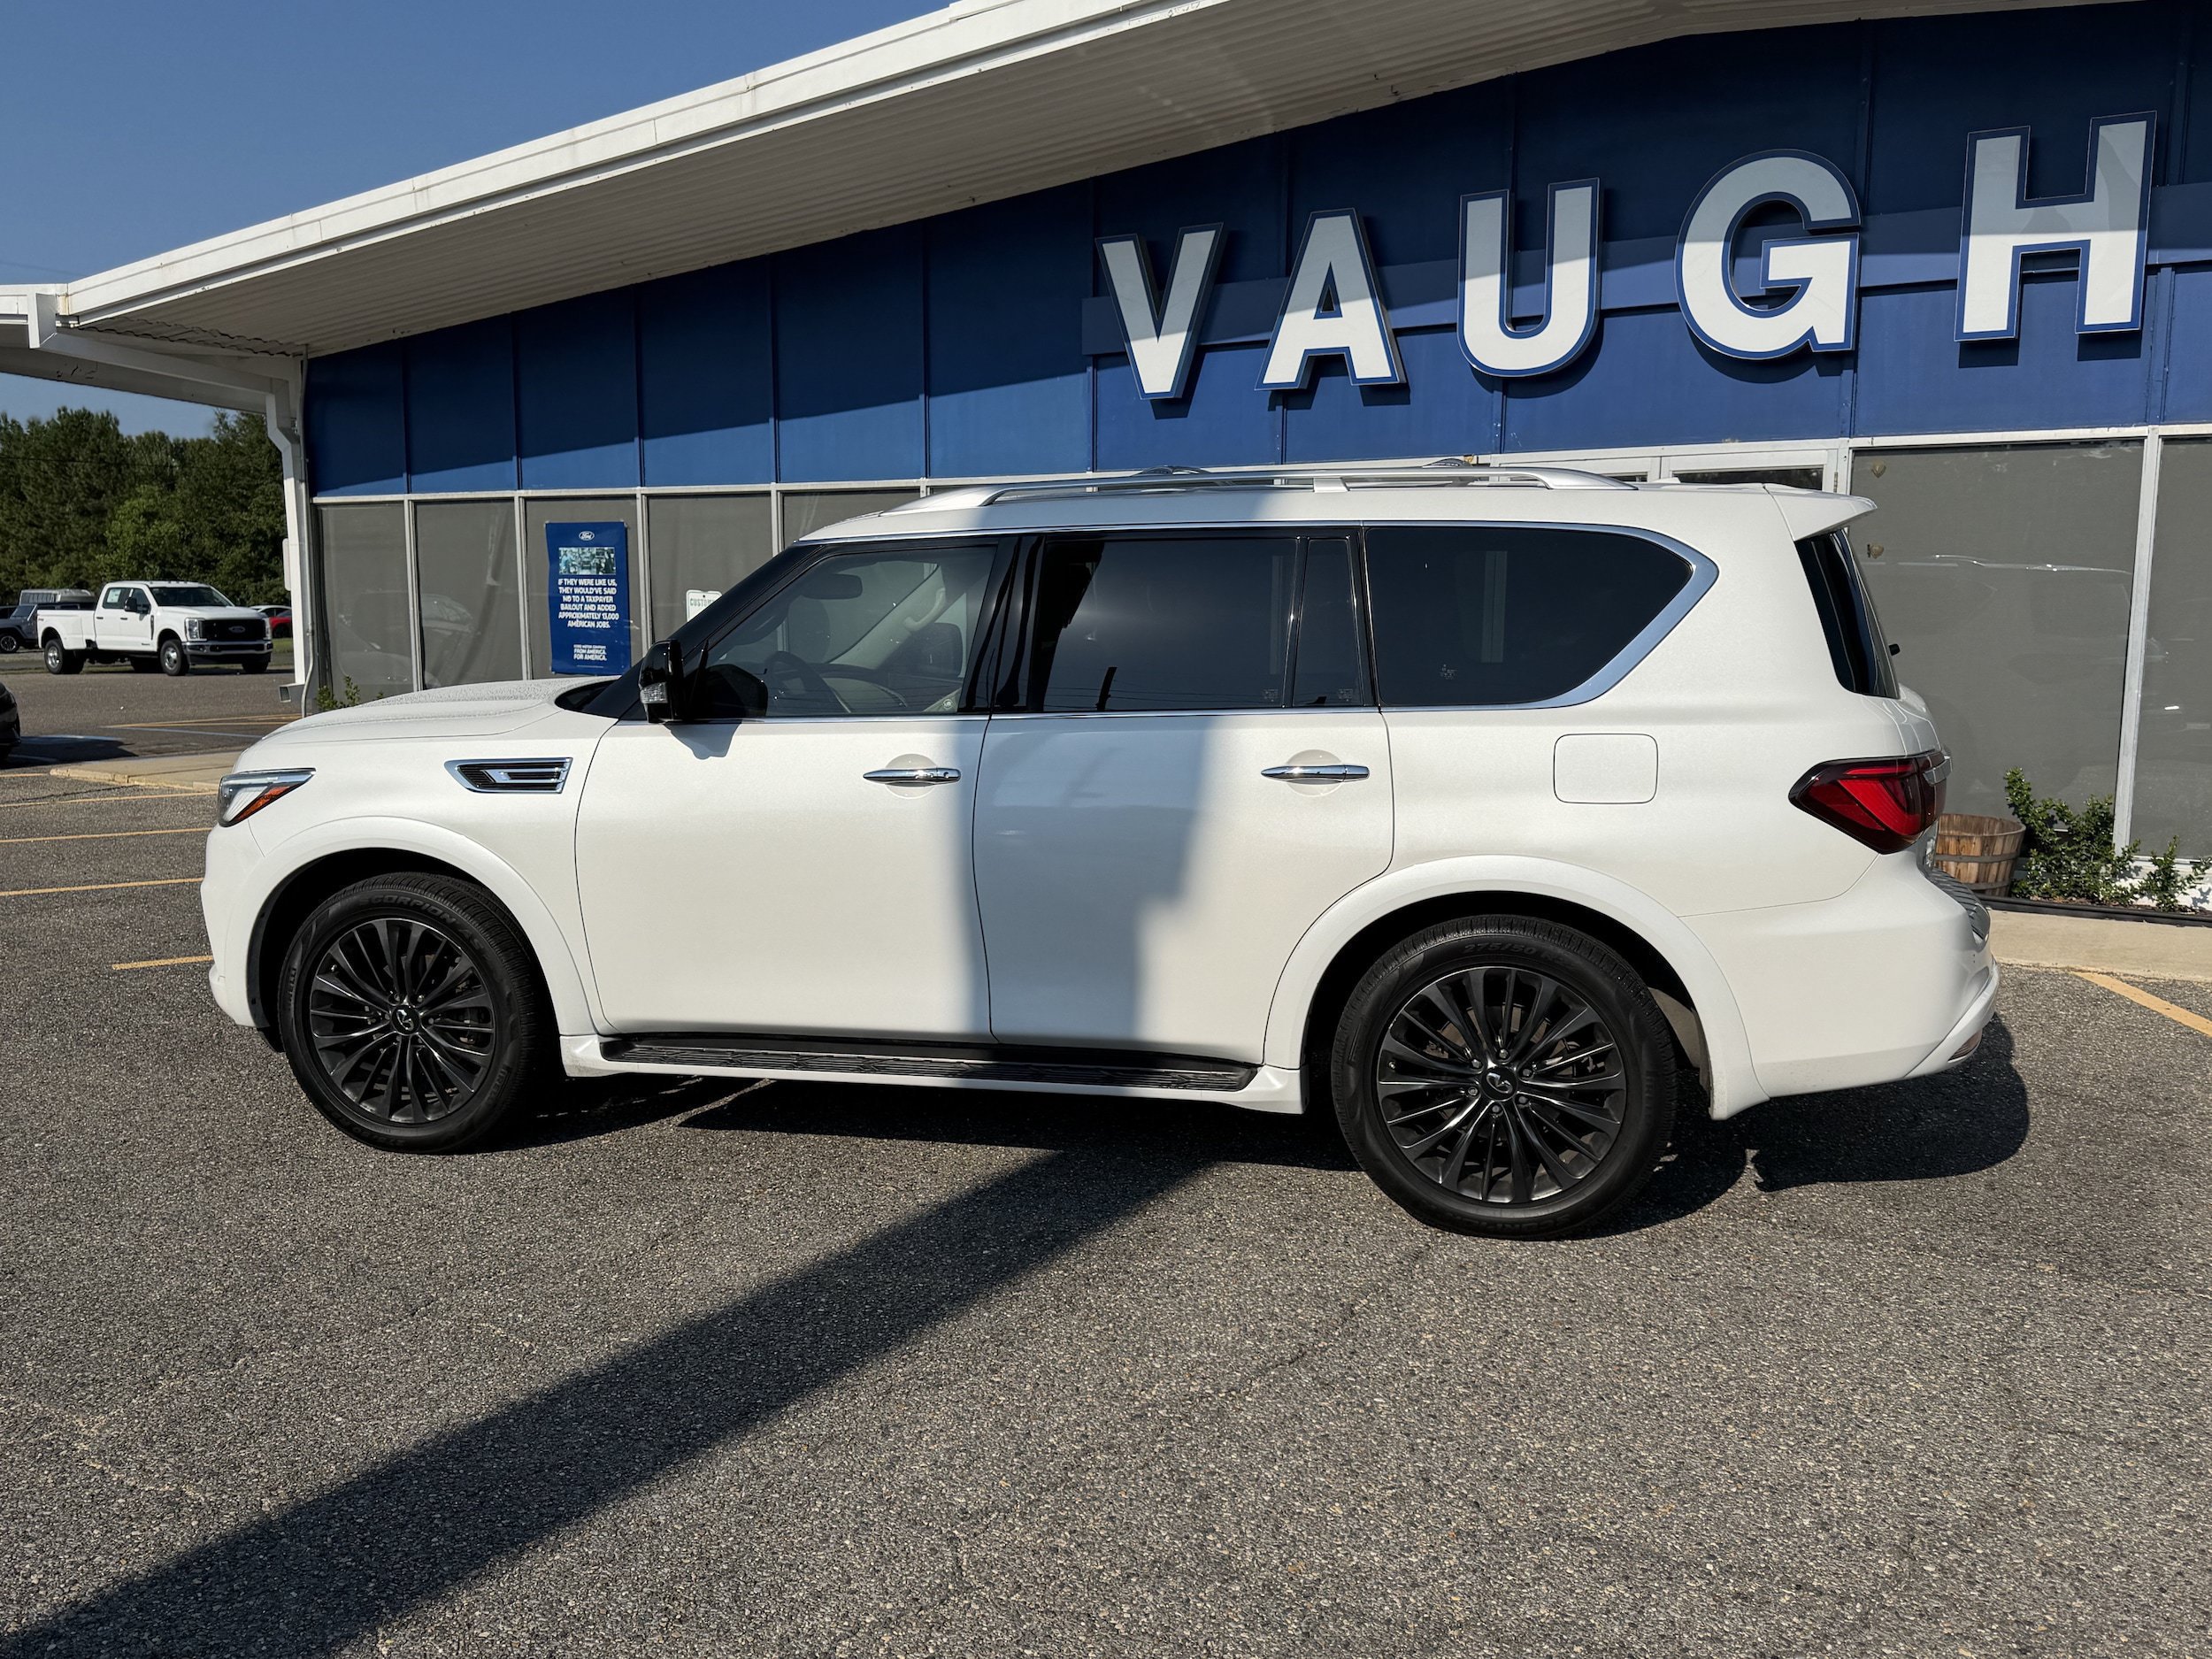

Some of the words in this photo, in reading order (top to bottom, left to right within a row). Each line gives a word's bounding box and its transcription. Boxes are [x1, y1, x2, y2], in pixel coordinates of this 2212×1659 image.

[1094, 111, 2157, 401] VAUGH
[567, 619, 595, 628] AMERICAN
[358, 894, 457, 925] SCORPION
[1464, 942, 1537, 955] 275/50
